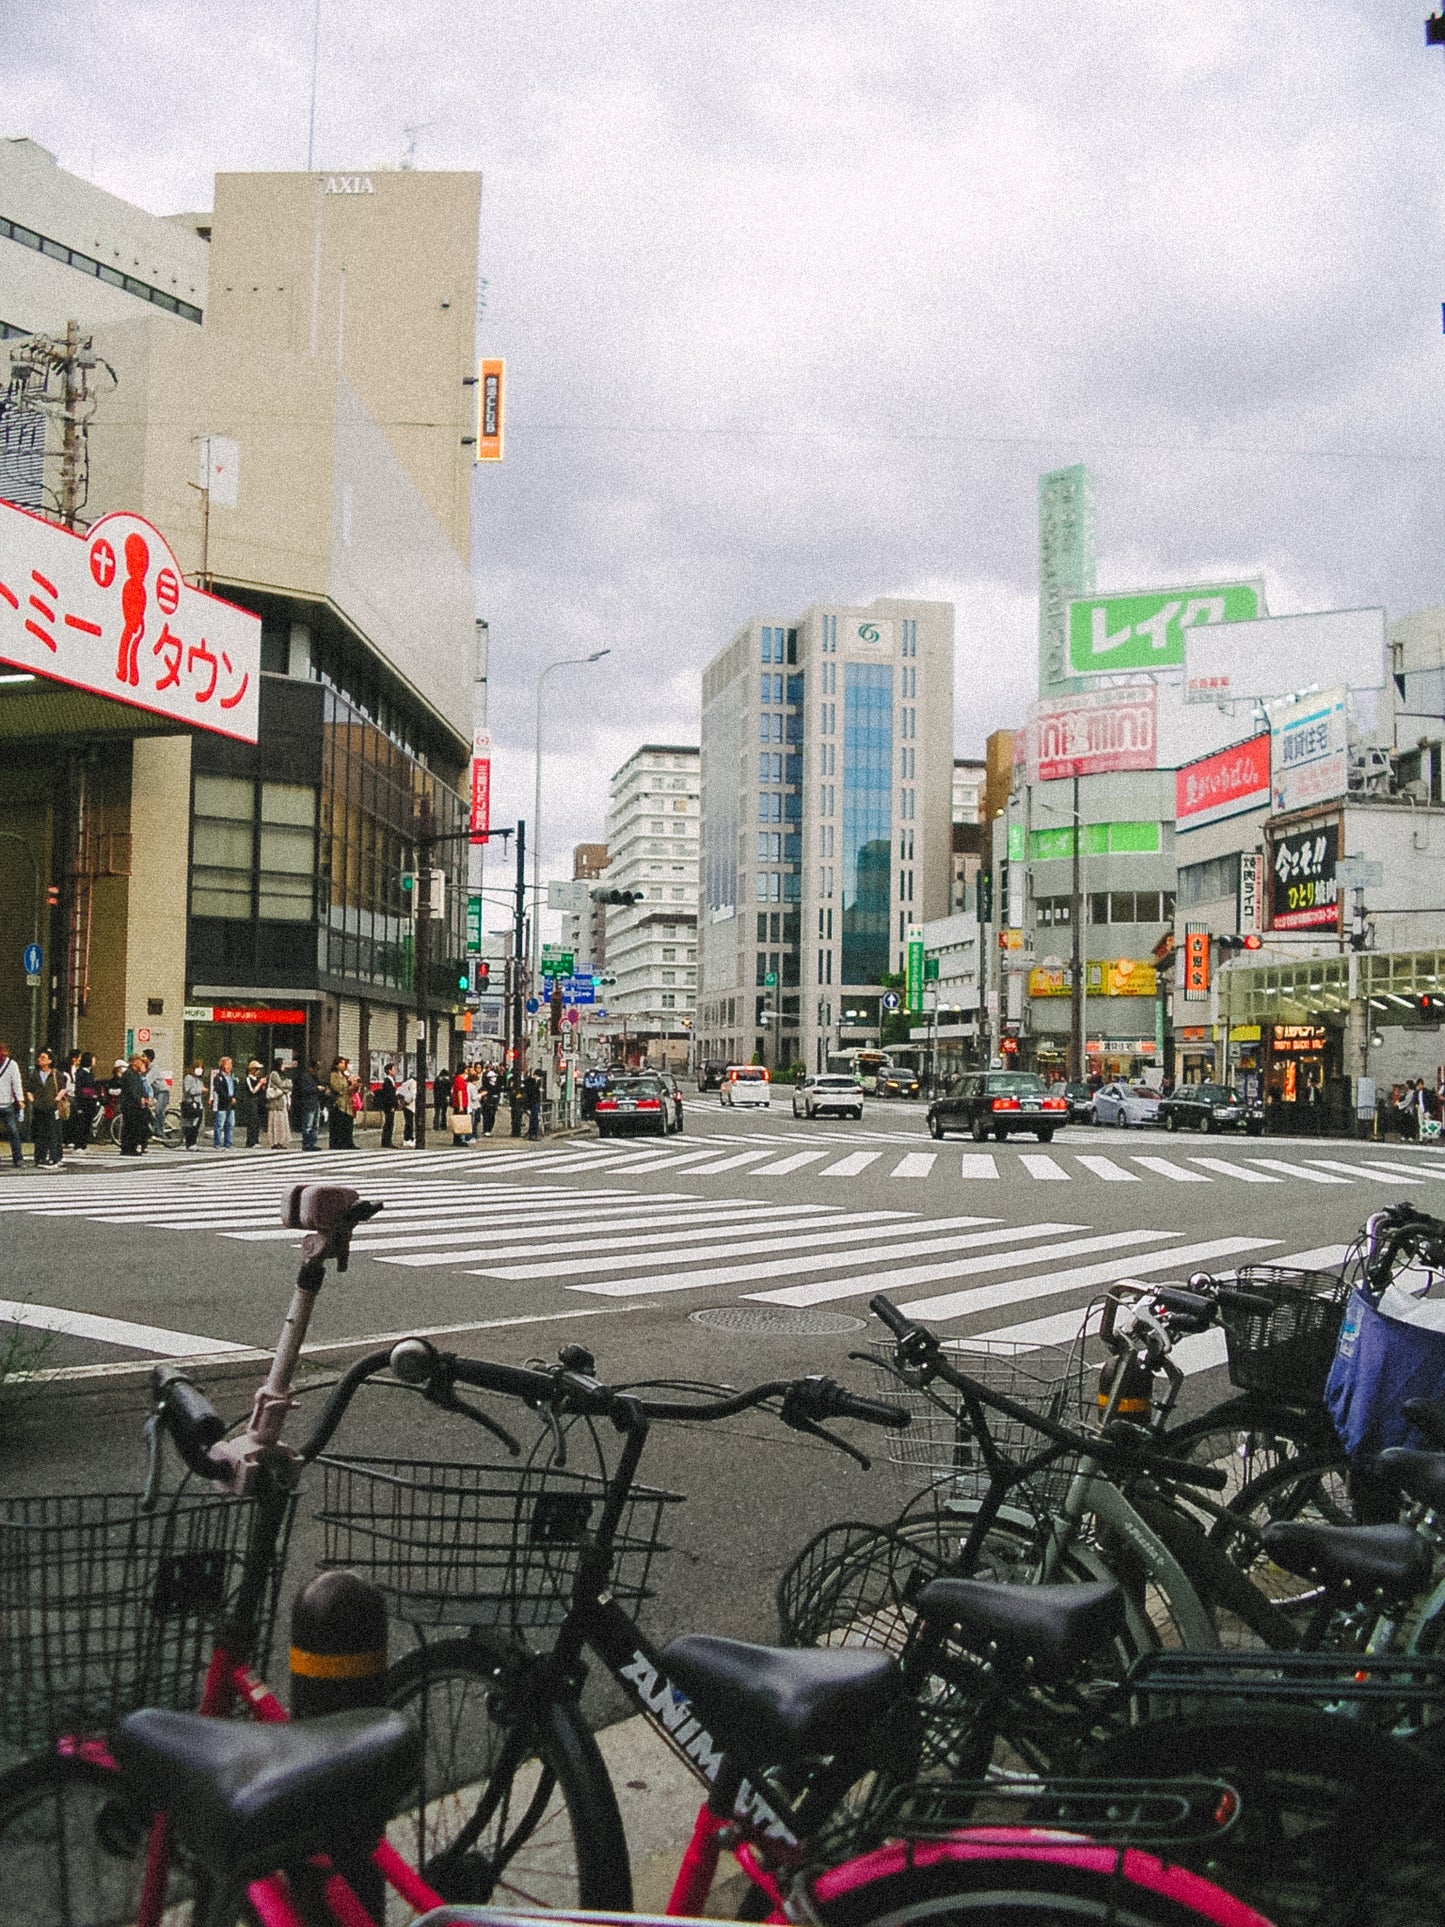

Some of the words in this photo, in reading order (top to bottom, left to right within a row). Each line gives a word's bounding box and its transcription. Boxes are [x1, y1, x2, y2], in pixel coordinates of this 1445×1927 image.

[326, 176, 373, 194] AXIA
[152, 621, 249, 709] タウン
[1282, 723, 1328, 763] 賃貸住宅
